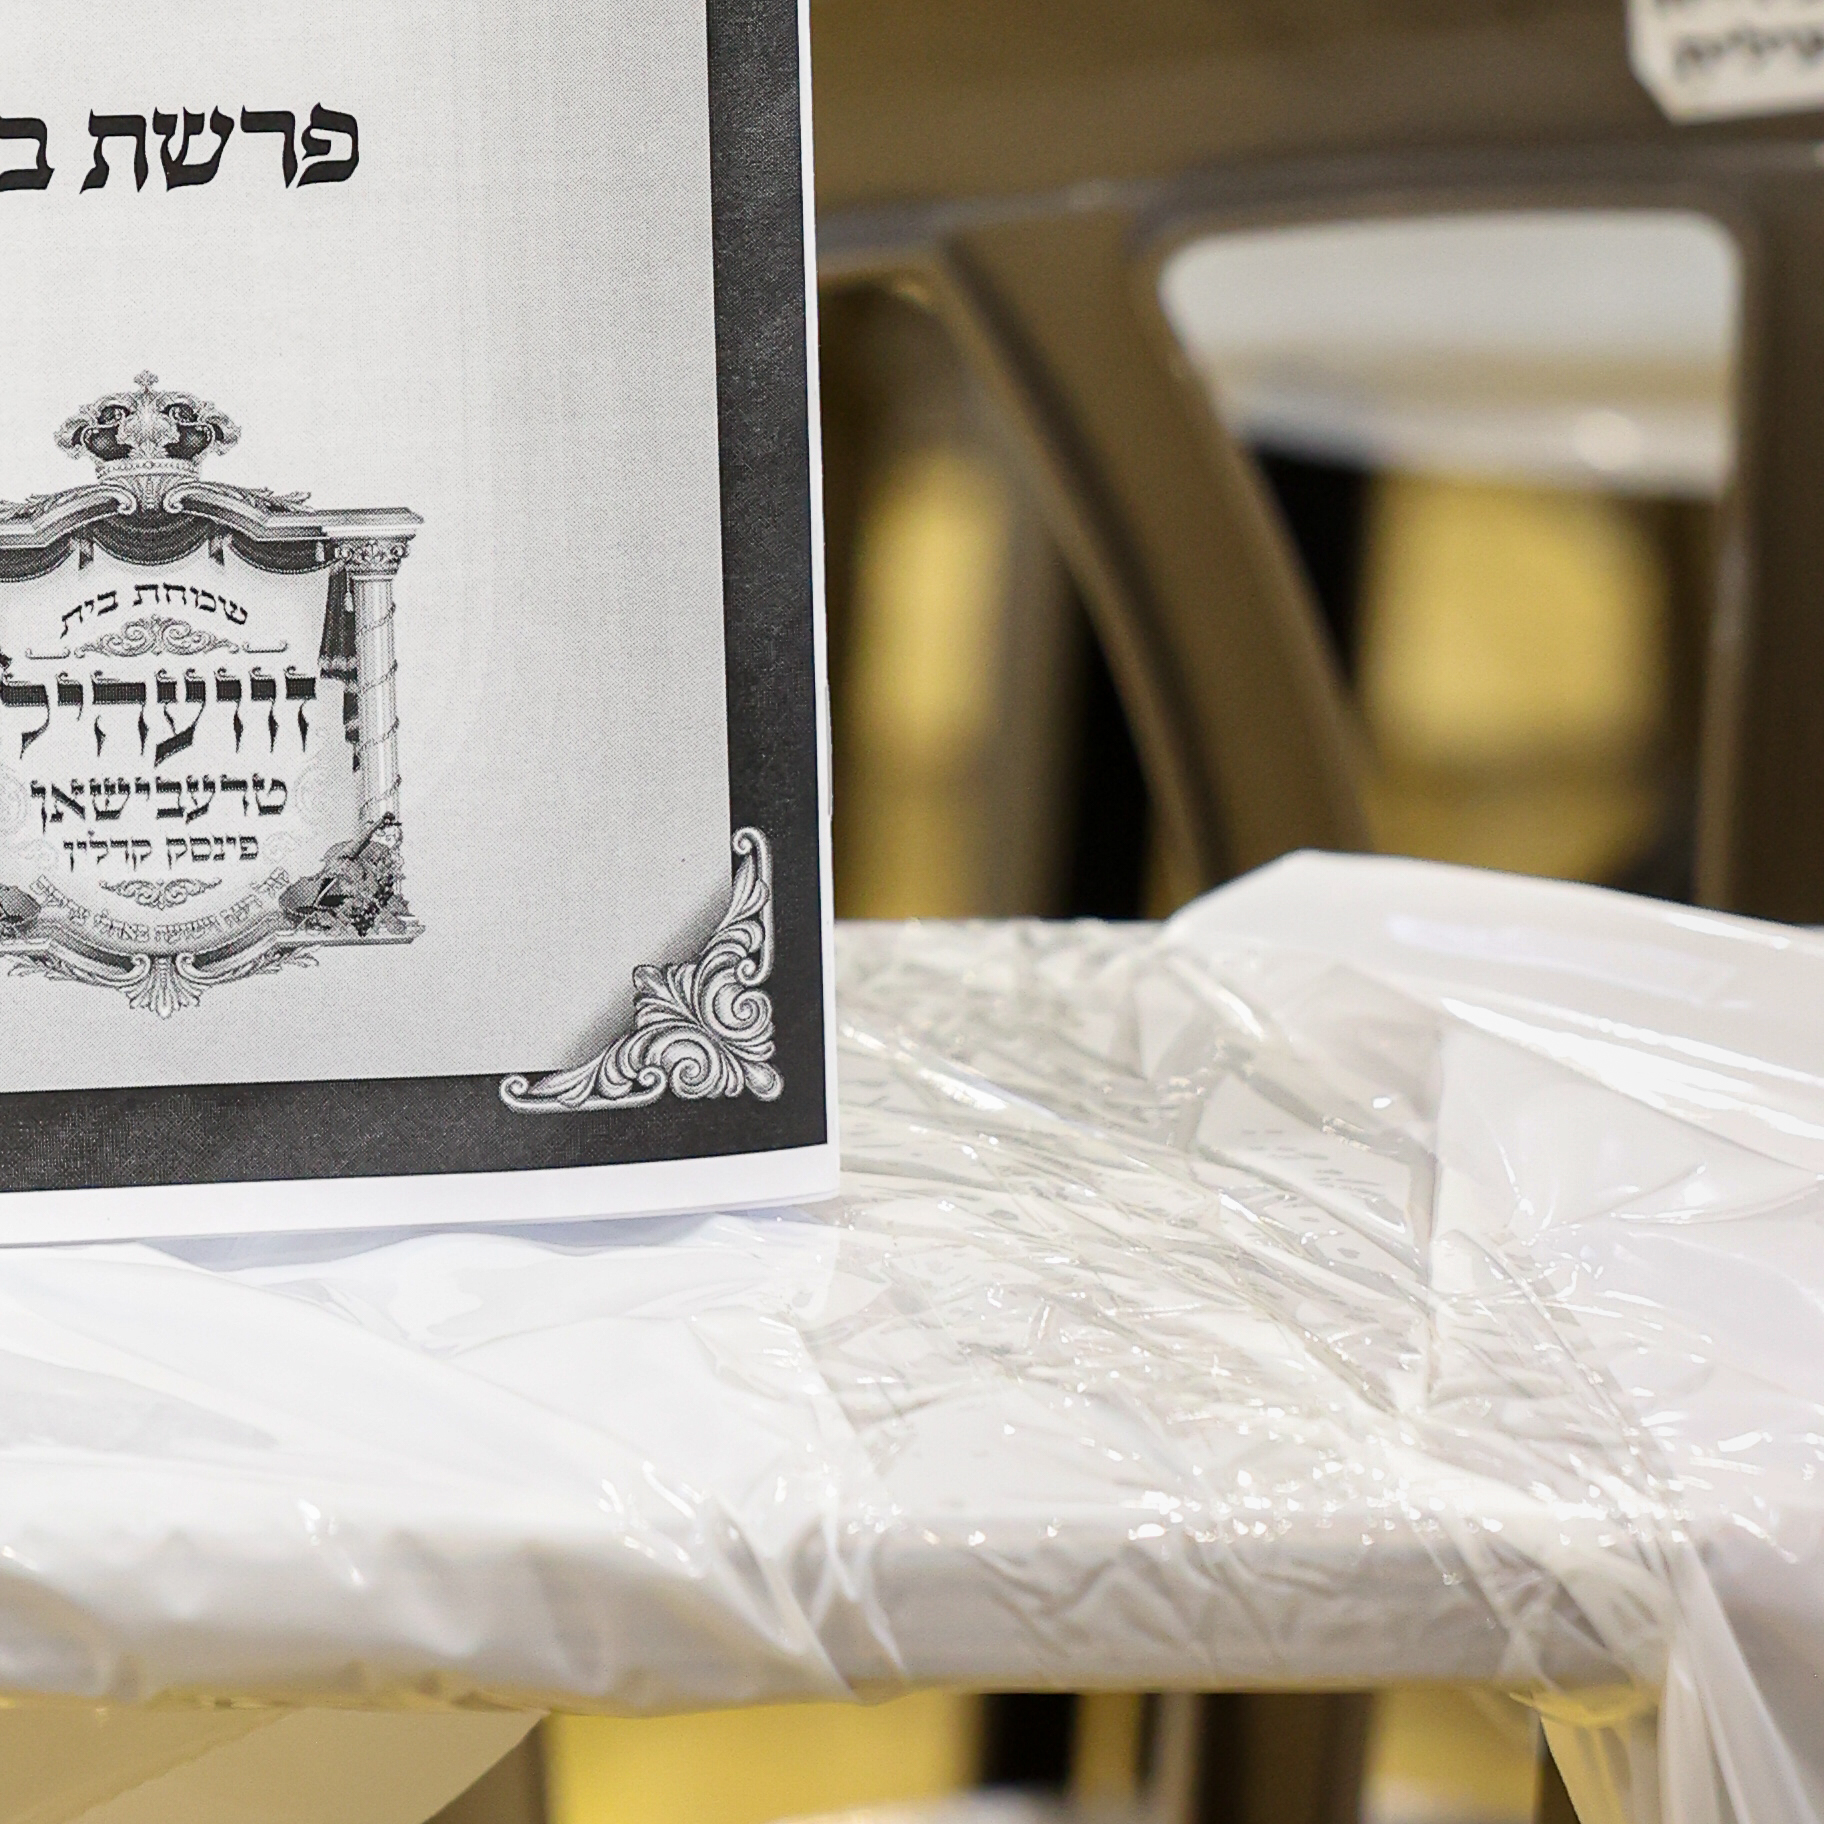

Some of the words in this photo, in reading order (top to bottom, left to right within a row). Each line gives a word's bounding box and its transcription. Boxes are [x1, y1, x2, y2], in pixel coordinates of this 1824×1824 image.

[79, 102, 360, 194] פרשת
[60, 590, 120, 639] בית
[132, 582, 249, 626] שמחת
[30, 773, 288, 834] טרעבישאן
[63, 829, 153, 873] קרלין
[165, 834, 259, 870] פינסק
